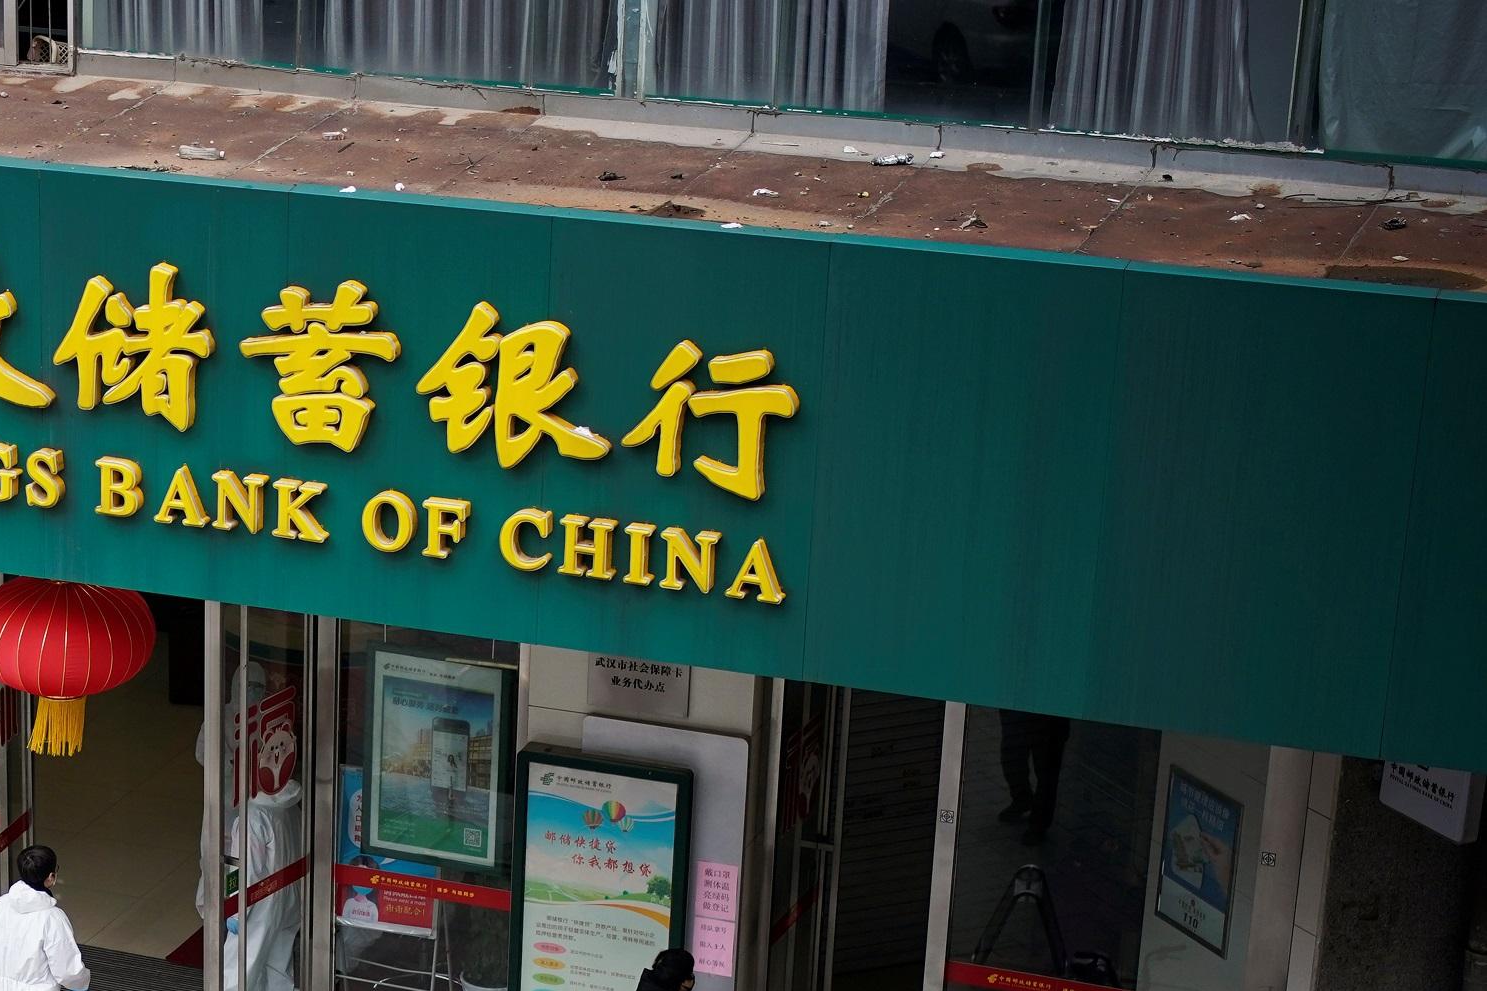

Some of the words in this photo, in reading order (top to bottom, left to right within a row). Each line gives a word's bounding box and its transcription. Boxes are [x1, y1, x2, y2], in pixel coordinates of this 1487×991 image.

[94, 455, 330, 544] BANK
[361, 489, 472, 560] OF
[498, 507, 787, 606] CHINA
[595, 657, 683, 678] 武汉市社会保障卡
[611, 675, 666, 693] 业务代办点
[557, 775, 612, 789] 中国邮政储蓄银行
[544, 830, 617, 854] 邮储快捷贷
[571, 853, 652, 878] 你我都想贷
[704, 868, 731, 879] 戴口罩
